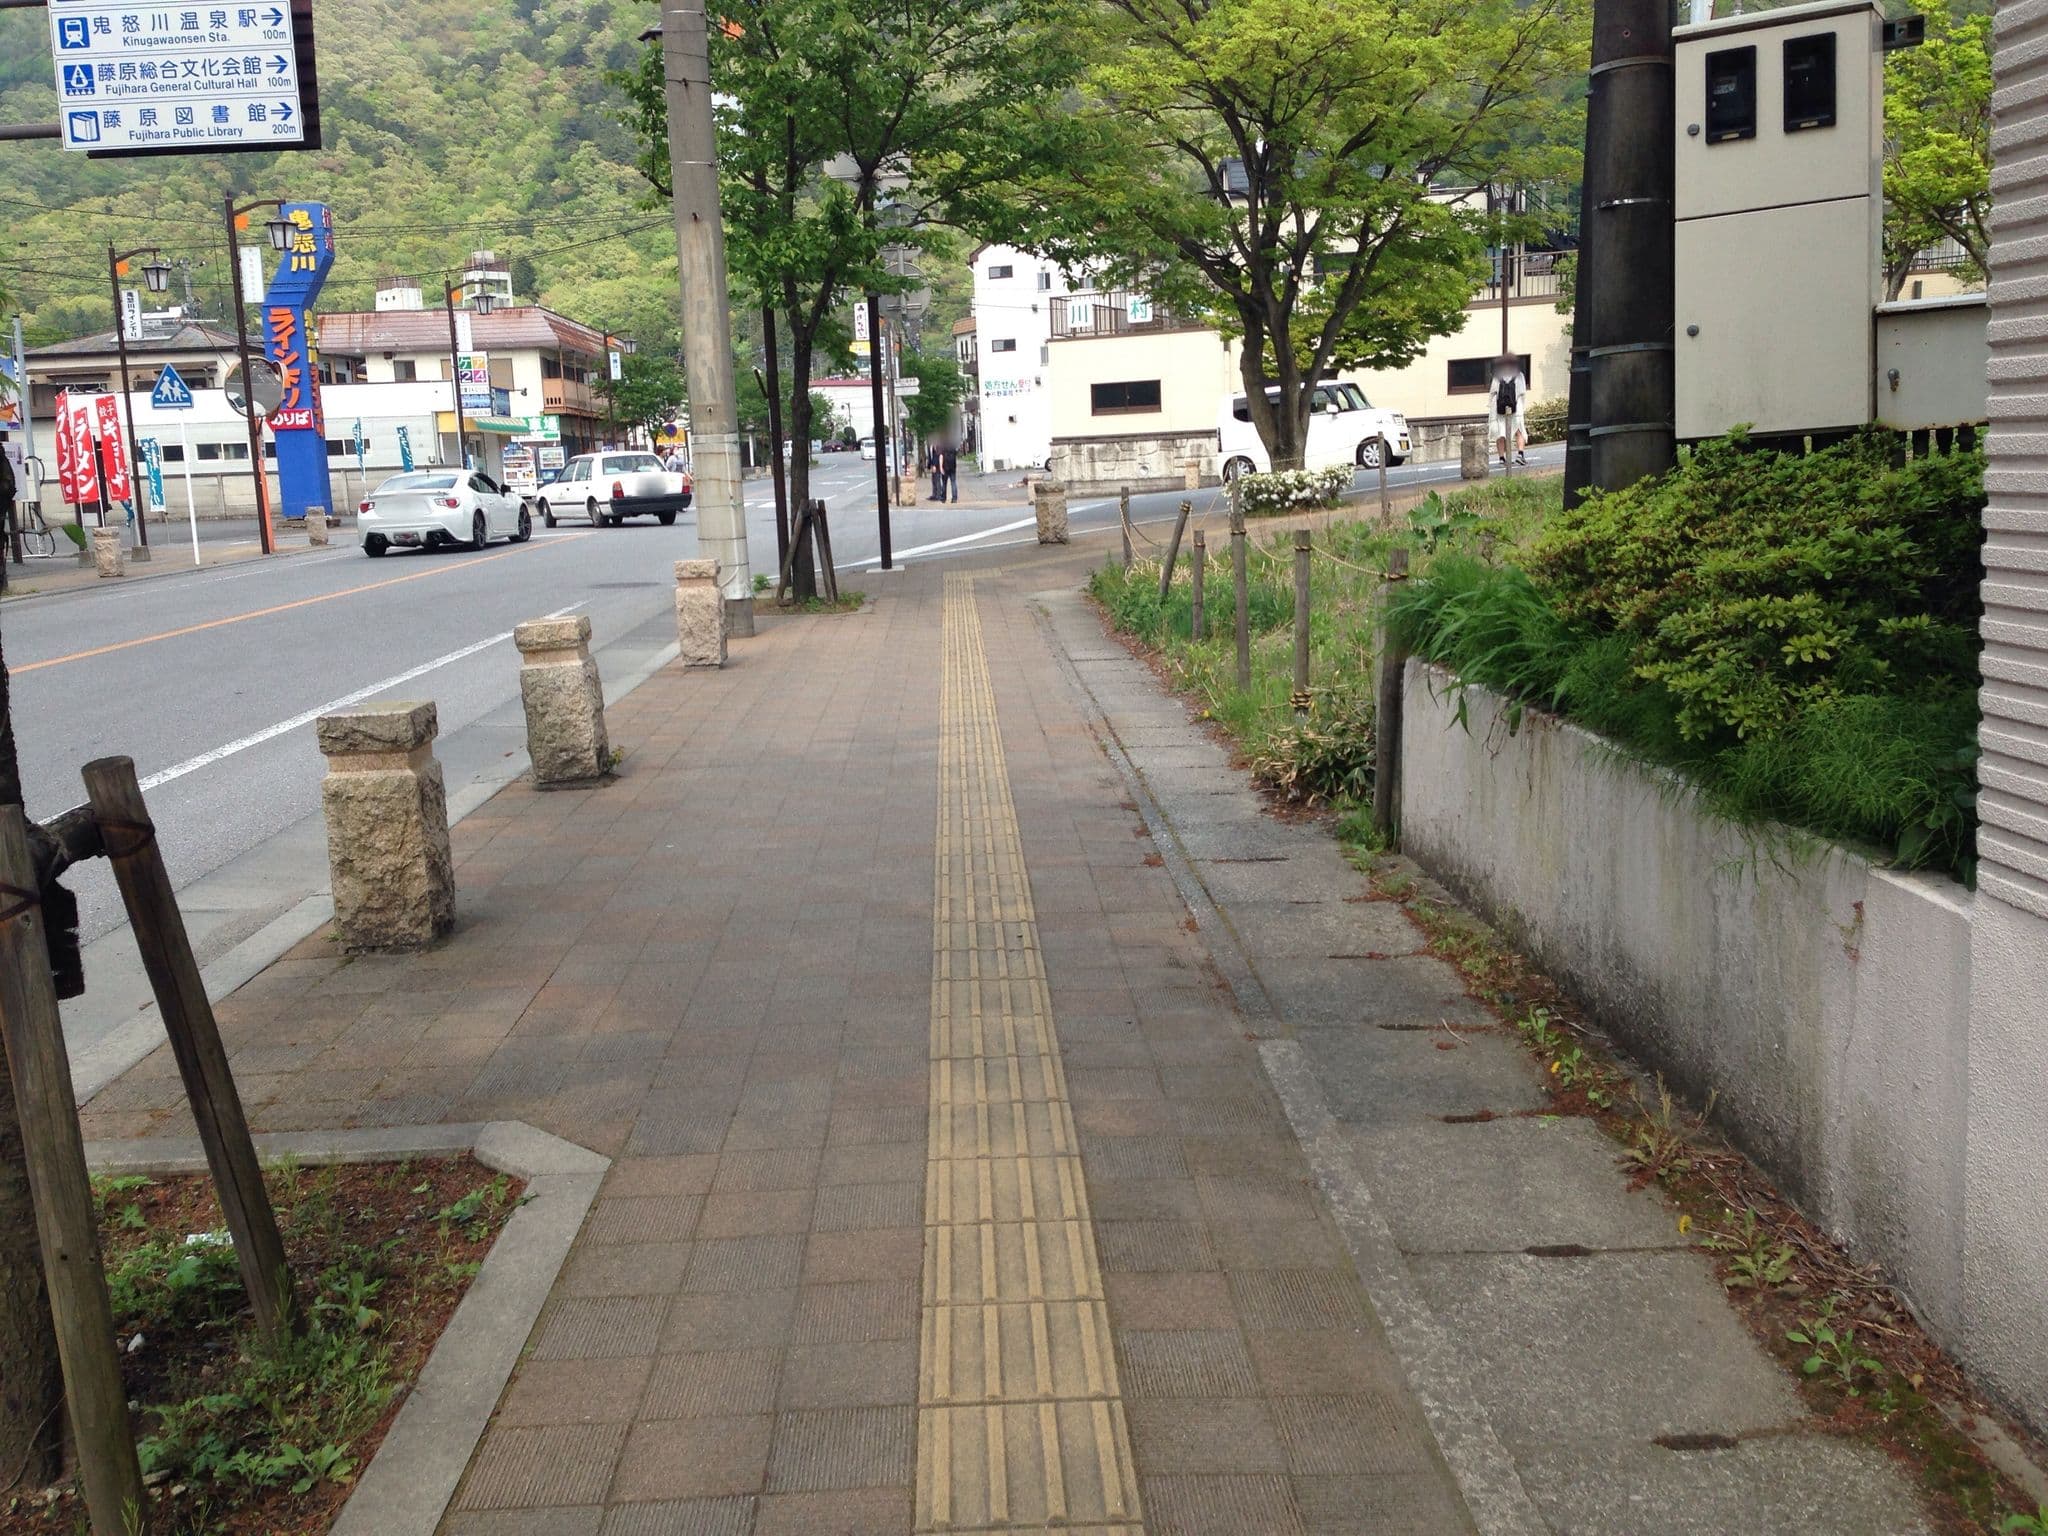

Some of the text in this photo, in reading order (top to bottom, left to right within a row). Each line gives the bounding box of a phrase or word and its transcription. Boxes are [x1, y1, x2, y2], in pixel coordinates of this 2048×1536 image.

[93, 8, 258, 35] 鬼怒川温泉駅
[122, 32, 230, 47] Kinugawaonsen Sta.
[262, 29, 287, 41] 100m
[97, 56, 262, 82] 藤原総合文化会館
[105, 78, 258, 96] Fujihara General Cultural Hall
[267, 76, 292, 88] 100m
[103, 103, 267, 129] 藤原図書館
[129, 125, 244, 142] Fujihara Public Library
[272, 123, 296, 135] 200m
[289, 209, 317, 272] 鬼怒川
[1072, 297, 1149, 324] 川 村
[459, 356, 486, 370] ケア
[461, 370, 487, 383] 24
[271, 411, 311, 427] のりば
[75, 417, 95, 495] ラーメン
[103, 416, 124, 493] ギョーザ
